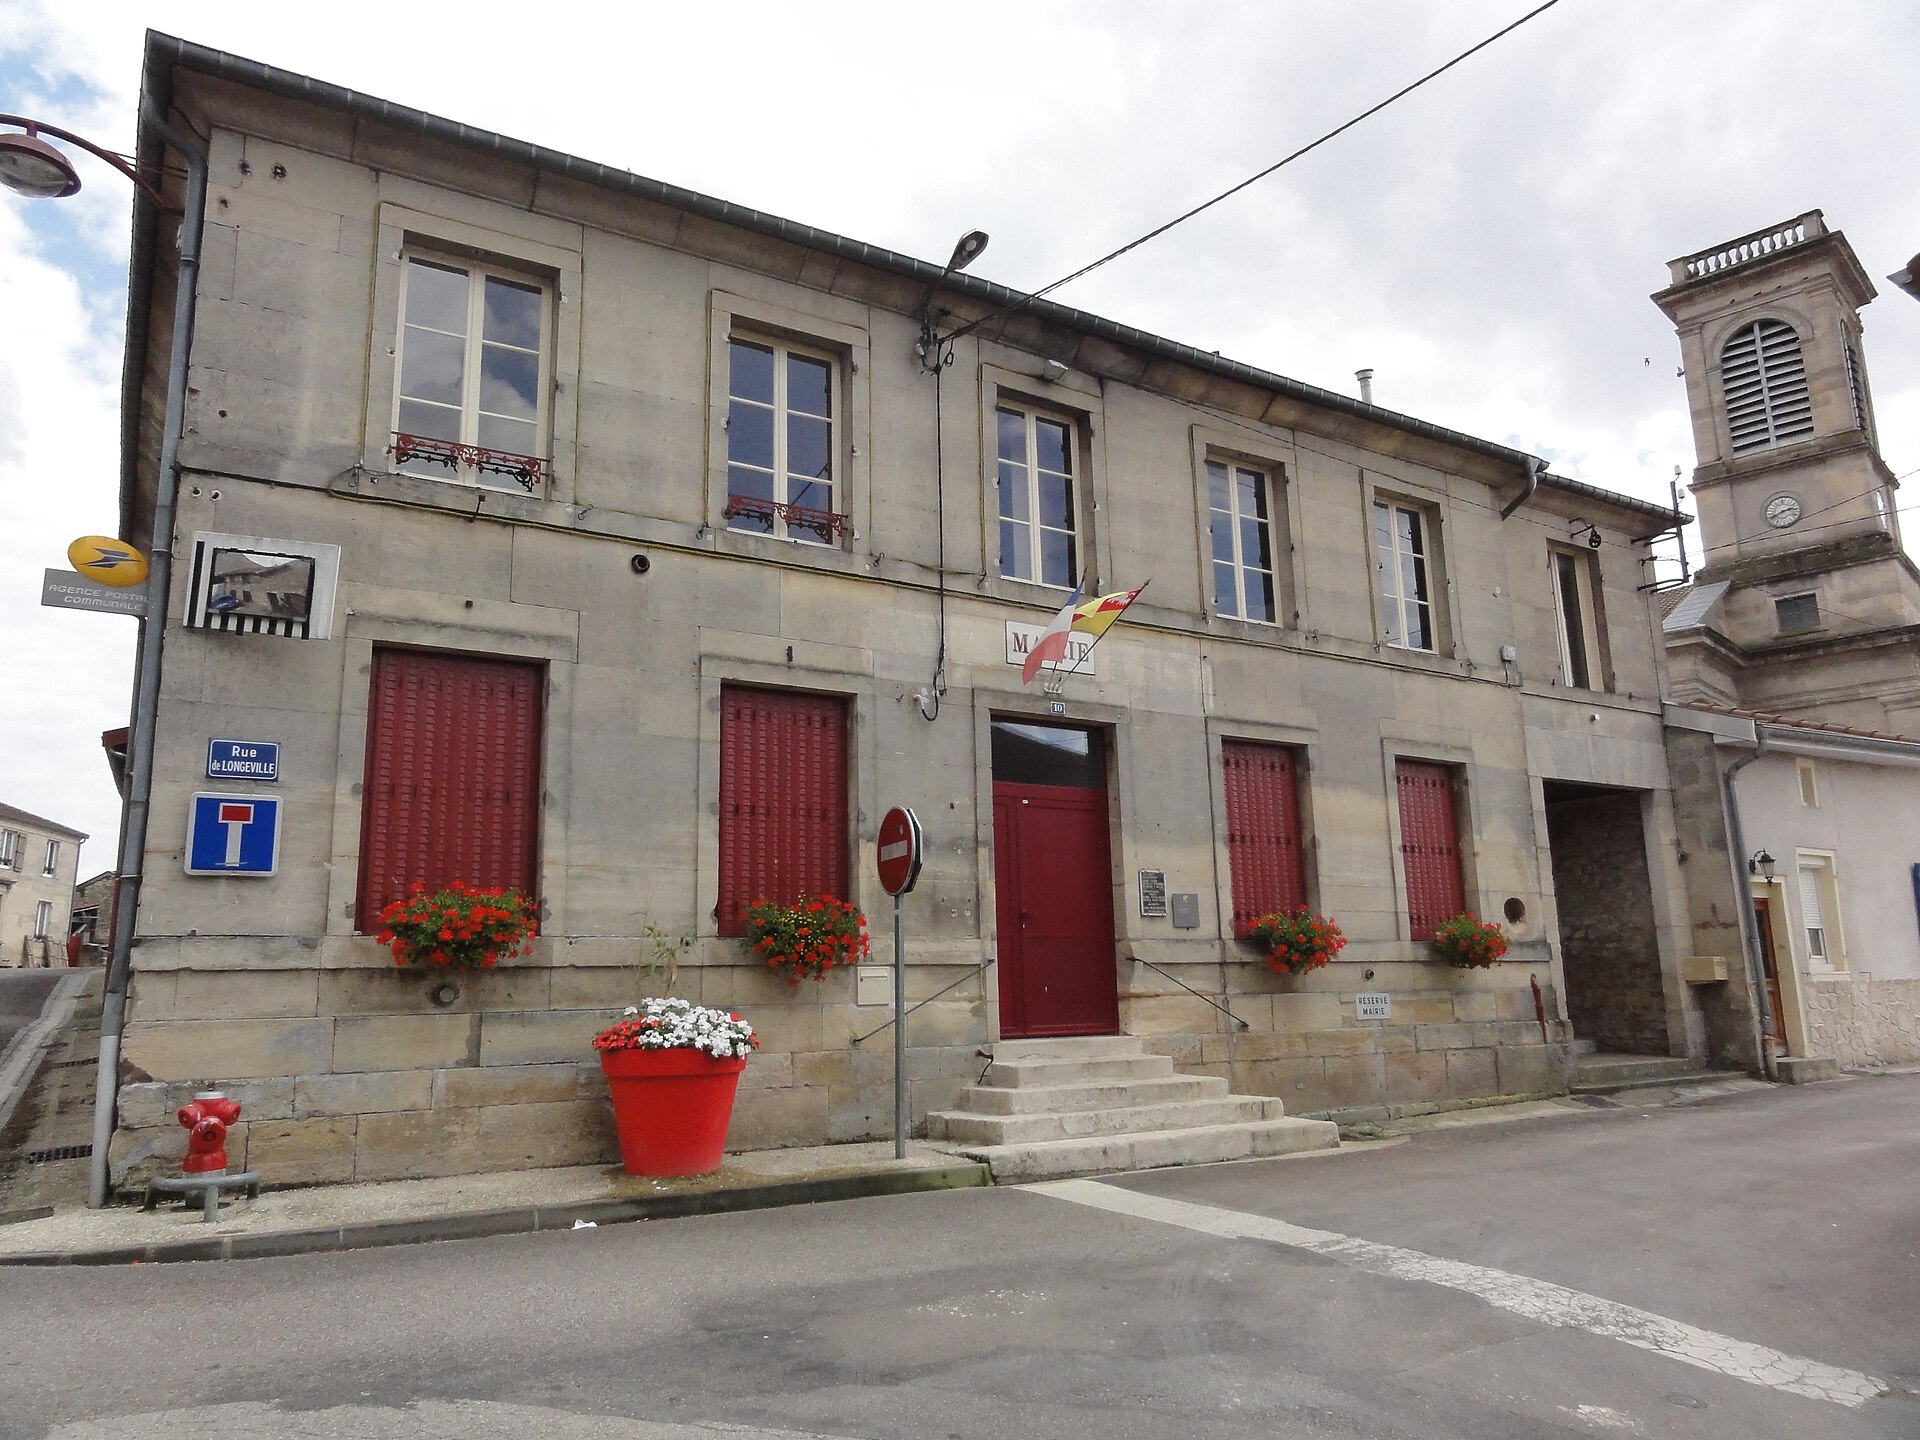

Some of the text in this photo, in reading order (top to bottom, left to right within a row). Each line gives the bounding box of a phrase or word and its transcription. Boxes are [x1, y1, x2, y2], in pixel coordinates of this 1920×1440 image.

[48, 584, 149, 602] AGENCE POSTAL
[64, 595, 143, 611] COMMUNALE
[1012, 632, 1089, 662] MIE
[1054, 703, 1062, 712] 10
[232, 745, 257, 758] Rue
[211, 760, 275, 774] de LONGEVILLE
[1362, 1007, 1385, 1015] MAIRIE
